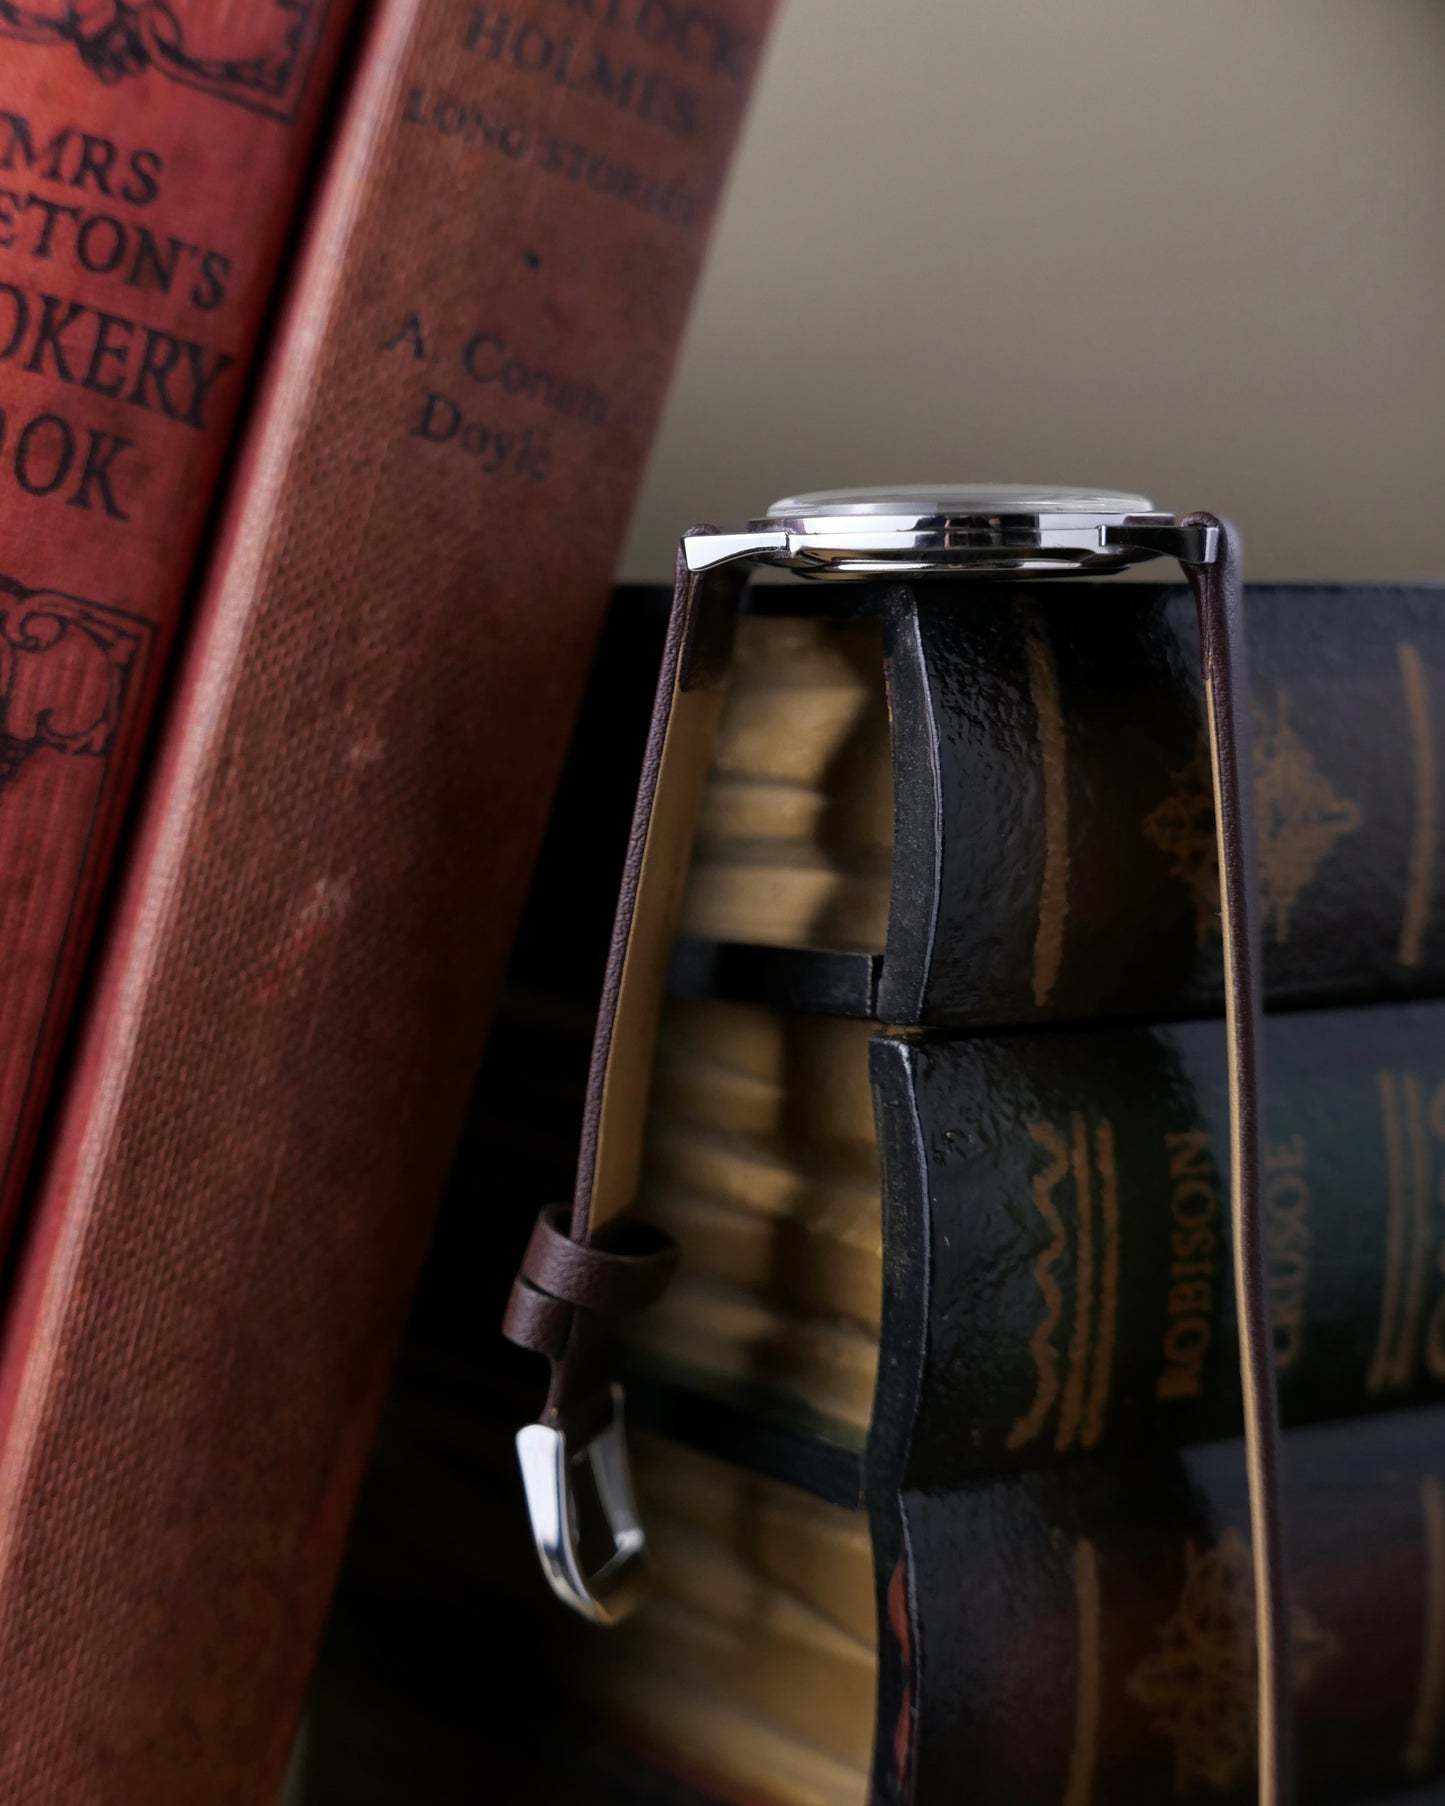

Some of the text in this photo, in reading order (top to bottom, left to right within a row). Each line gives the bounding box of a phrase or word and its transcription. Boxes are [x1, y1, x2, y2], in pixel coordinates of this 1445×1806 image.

[464, 8, 700, 138] HOLMES
[0, 110, 163, 206] MRS
[402, 86, 530, 160] LONG
[411, 393, 552, 480] Doyle
